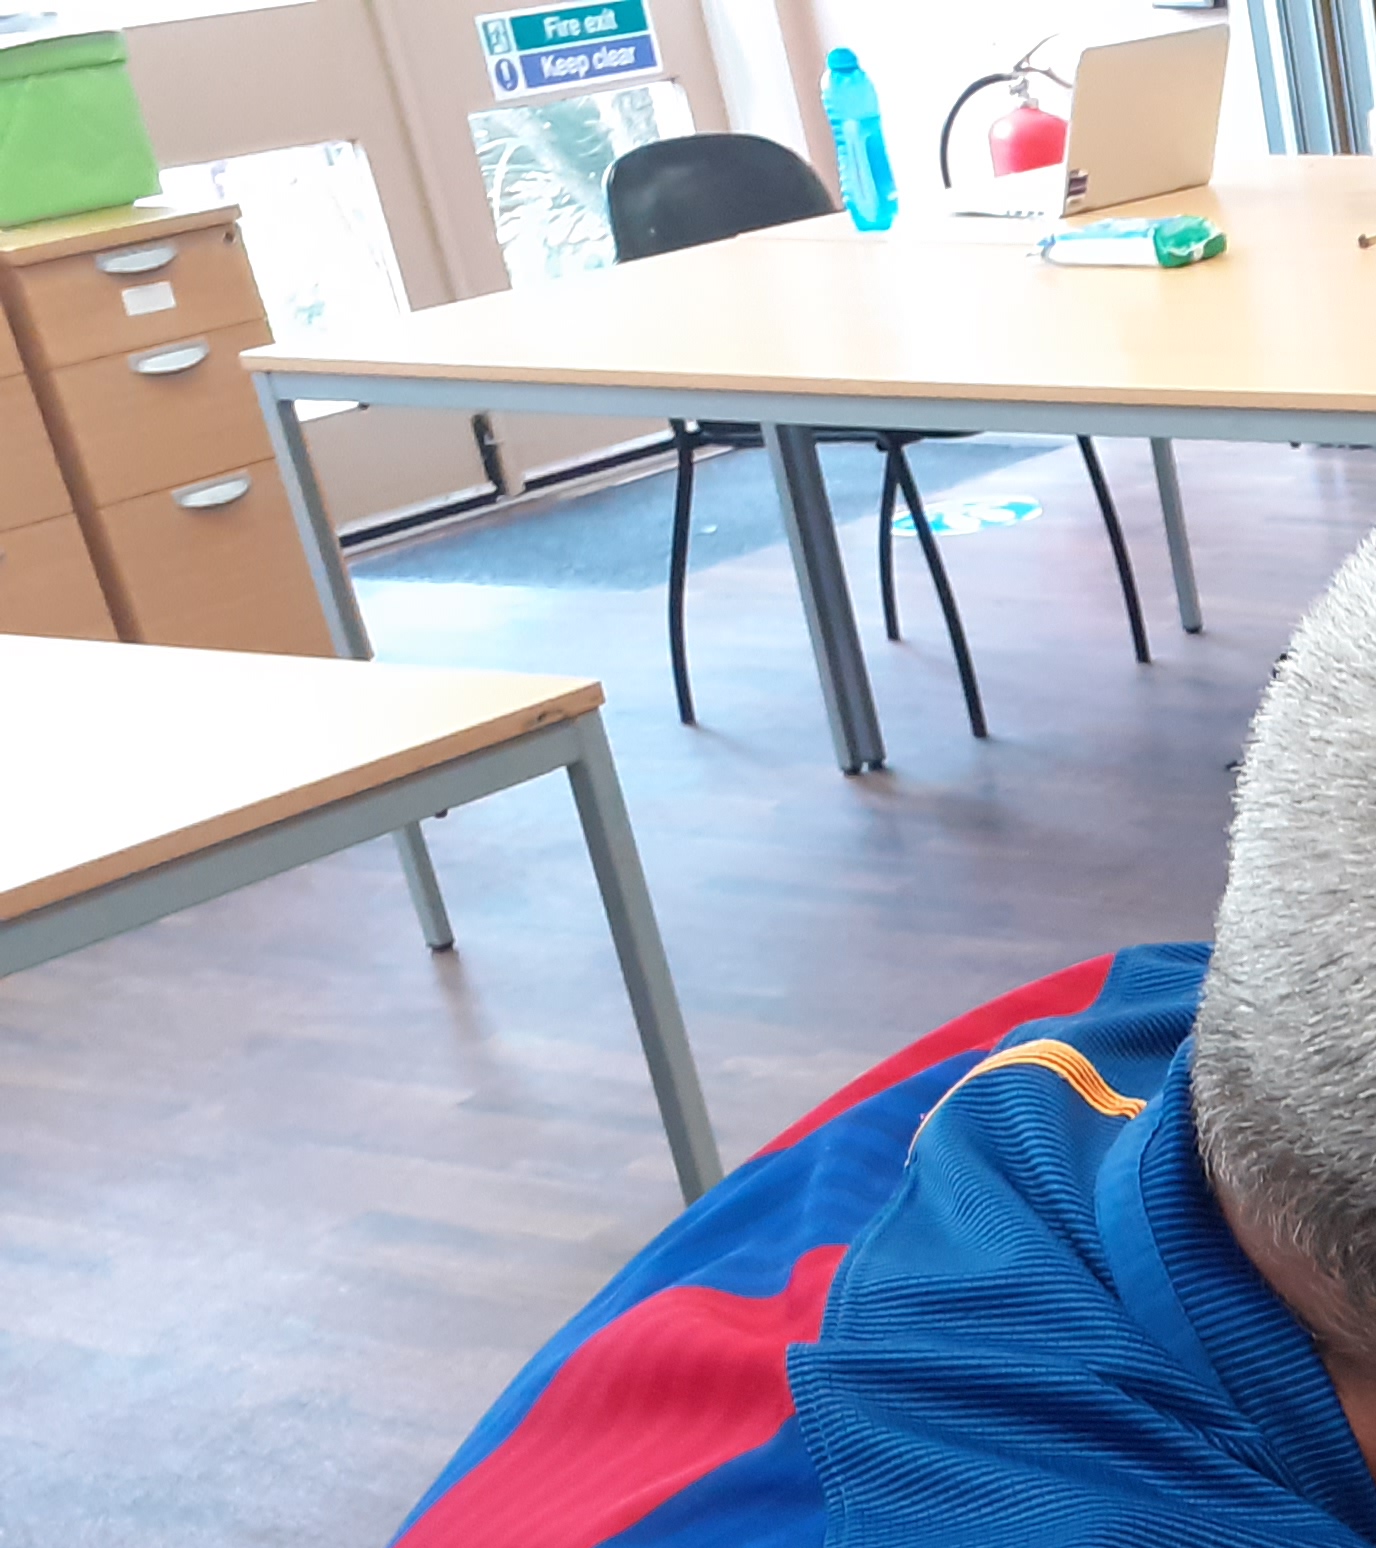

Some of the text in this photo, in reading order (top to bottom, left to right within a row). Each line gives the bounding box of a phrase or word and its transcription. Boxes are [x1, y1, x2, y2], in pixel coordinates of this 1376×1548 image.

[543, 8, 618, 39] Fire exit
[540, 46, 636, 79] Keep clear
